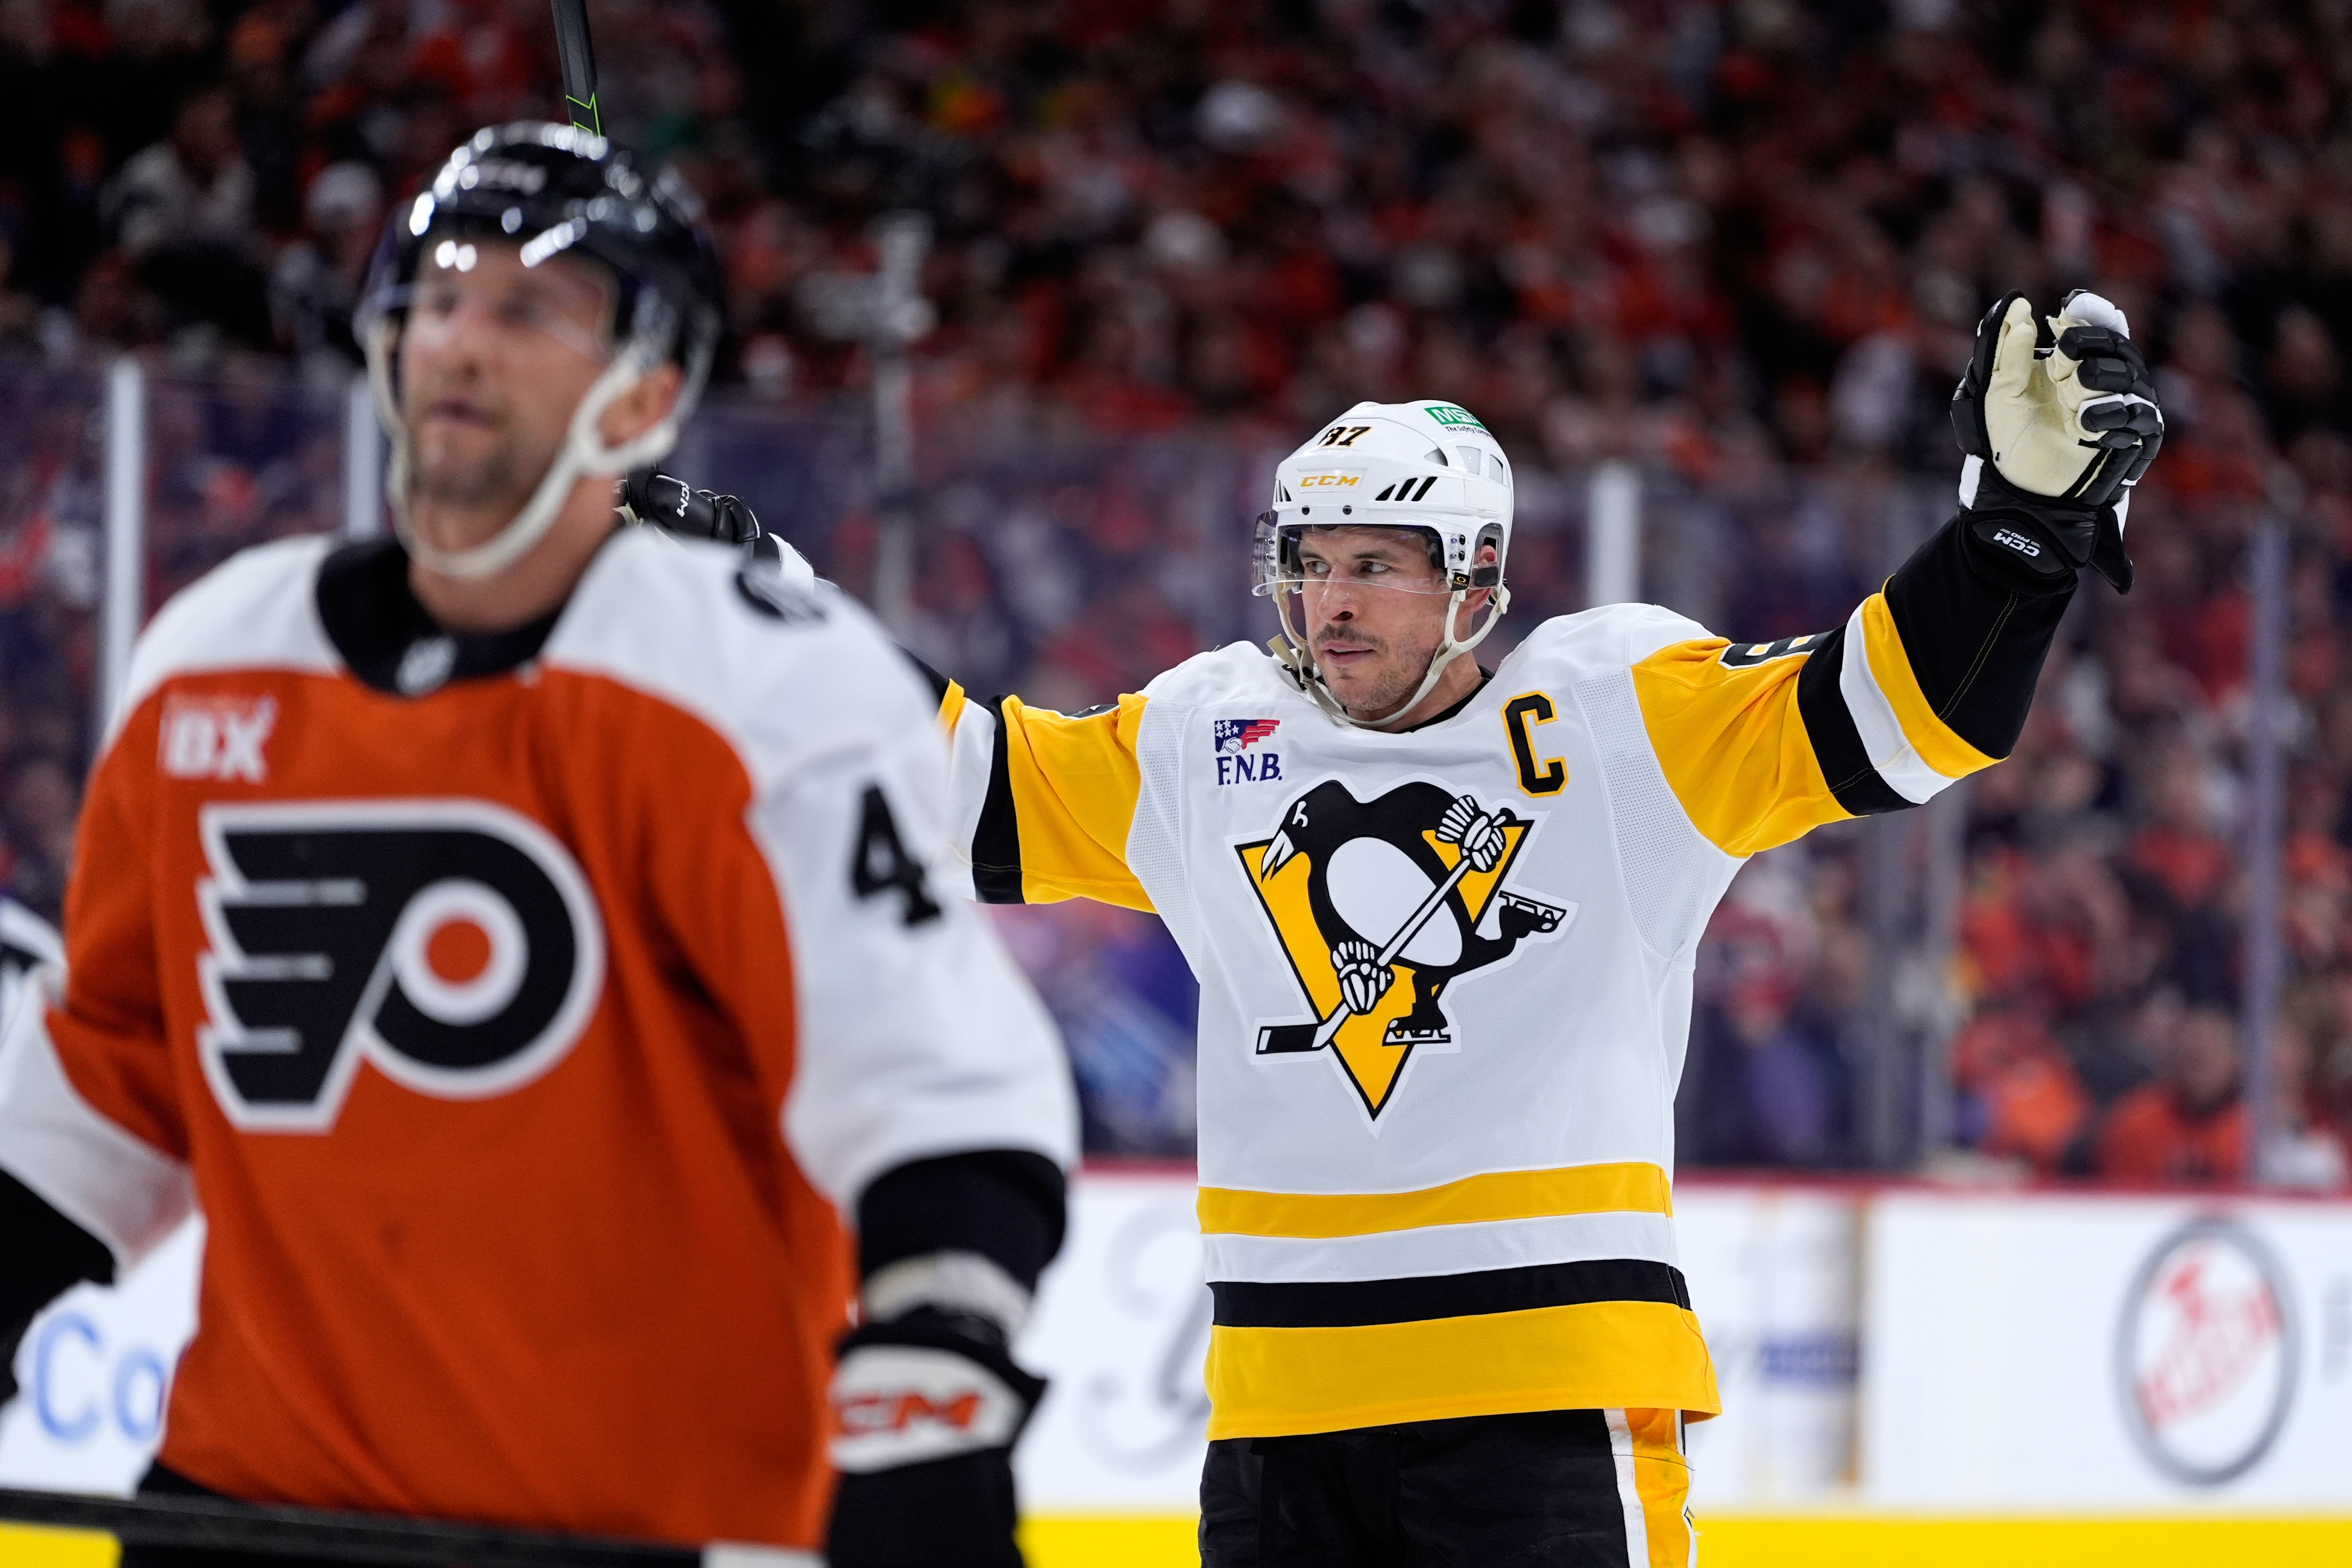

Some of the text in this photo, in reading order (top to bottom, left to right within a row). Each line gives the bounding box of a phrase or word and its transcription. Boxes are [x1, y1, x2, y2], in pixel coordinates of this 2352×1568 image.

[1316, 426, 1373, 447] 87
[1457, 425, 1475, 434] Safety
[1300, 475, 1360, 487] CCM
[1993, 532, 2040, 557] CCM
[2010, 532, 2031, 543] PRO
[1500, 690, 1570, 798] C
[1215, 753, 1282, 786] F.N.B.
